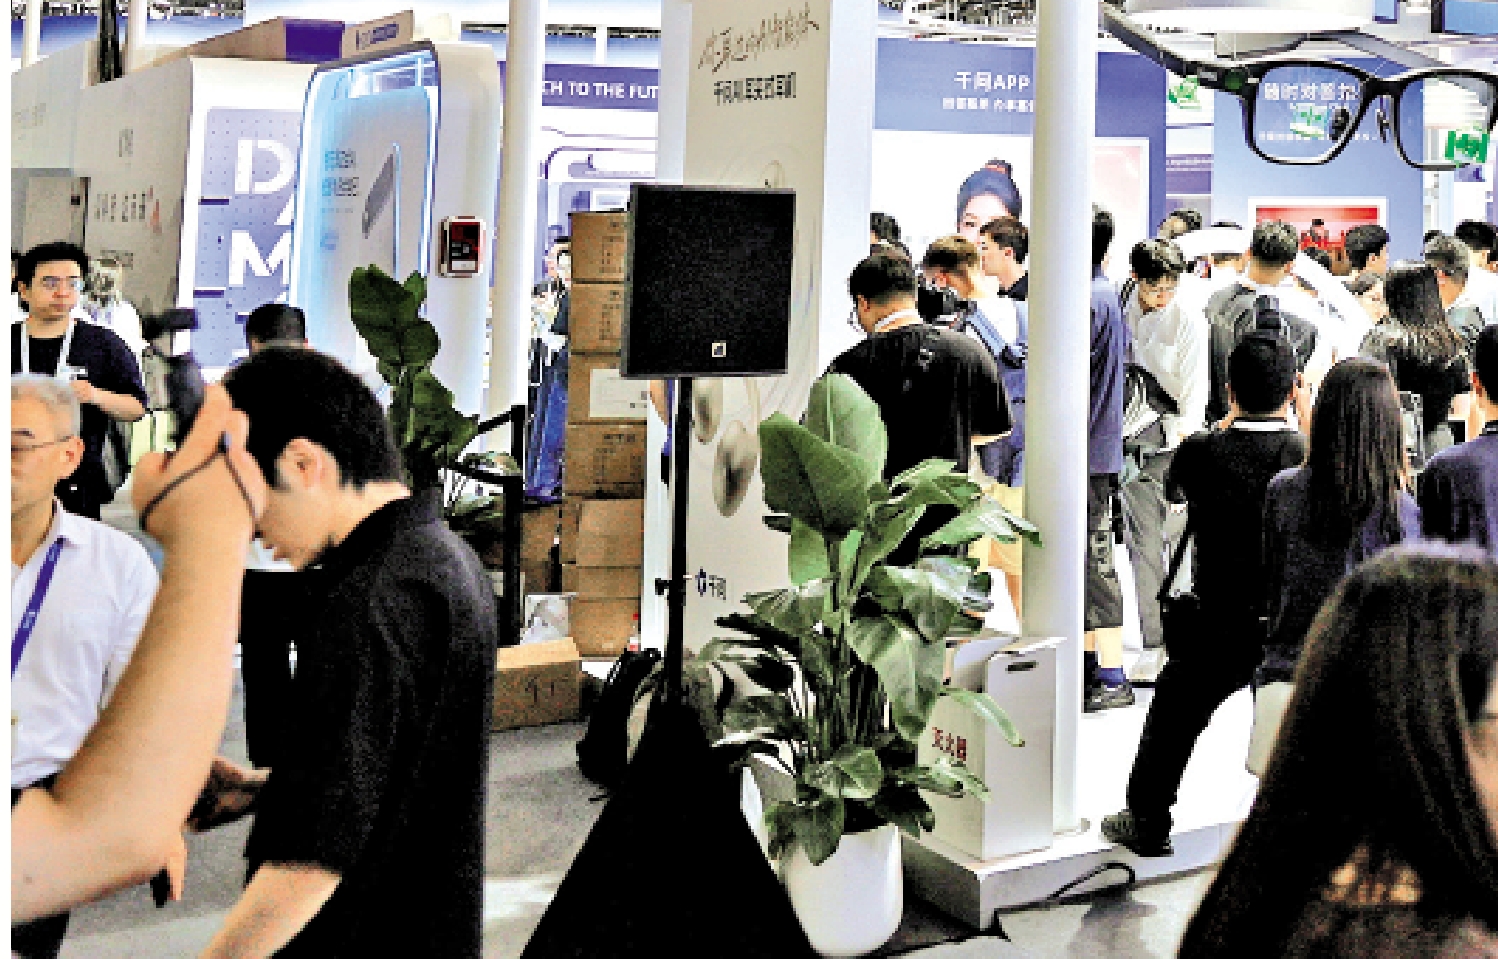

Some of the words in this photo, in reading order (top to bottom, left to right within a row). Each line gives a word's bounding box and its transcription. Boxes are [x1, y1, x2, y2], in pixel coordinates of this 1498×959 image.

[568, 81, 590, 97] TO
[593, 82, 626, 99] THE
[953, 71, 1031, 93] 千问APP
